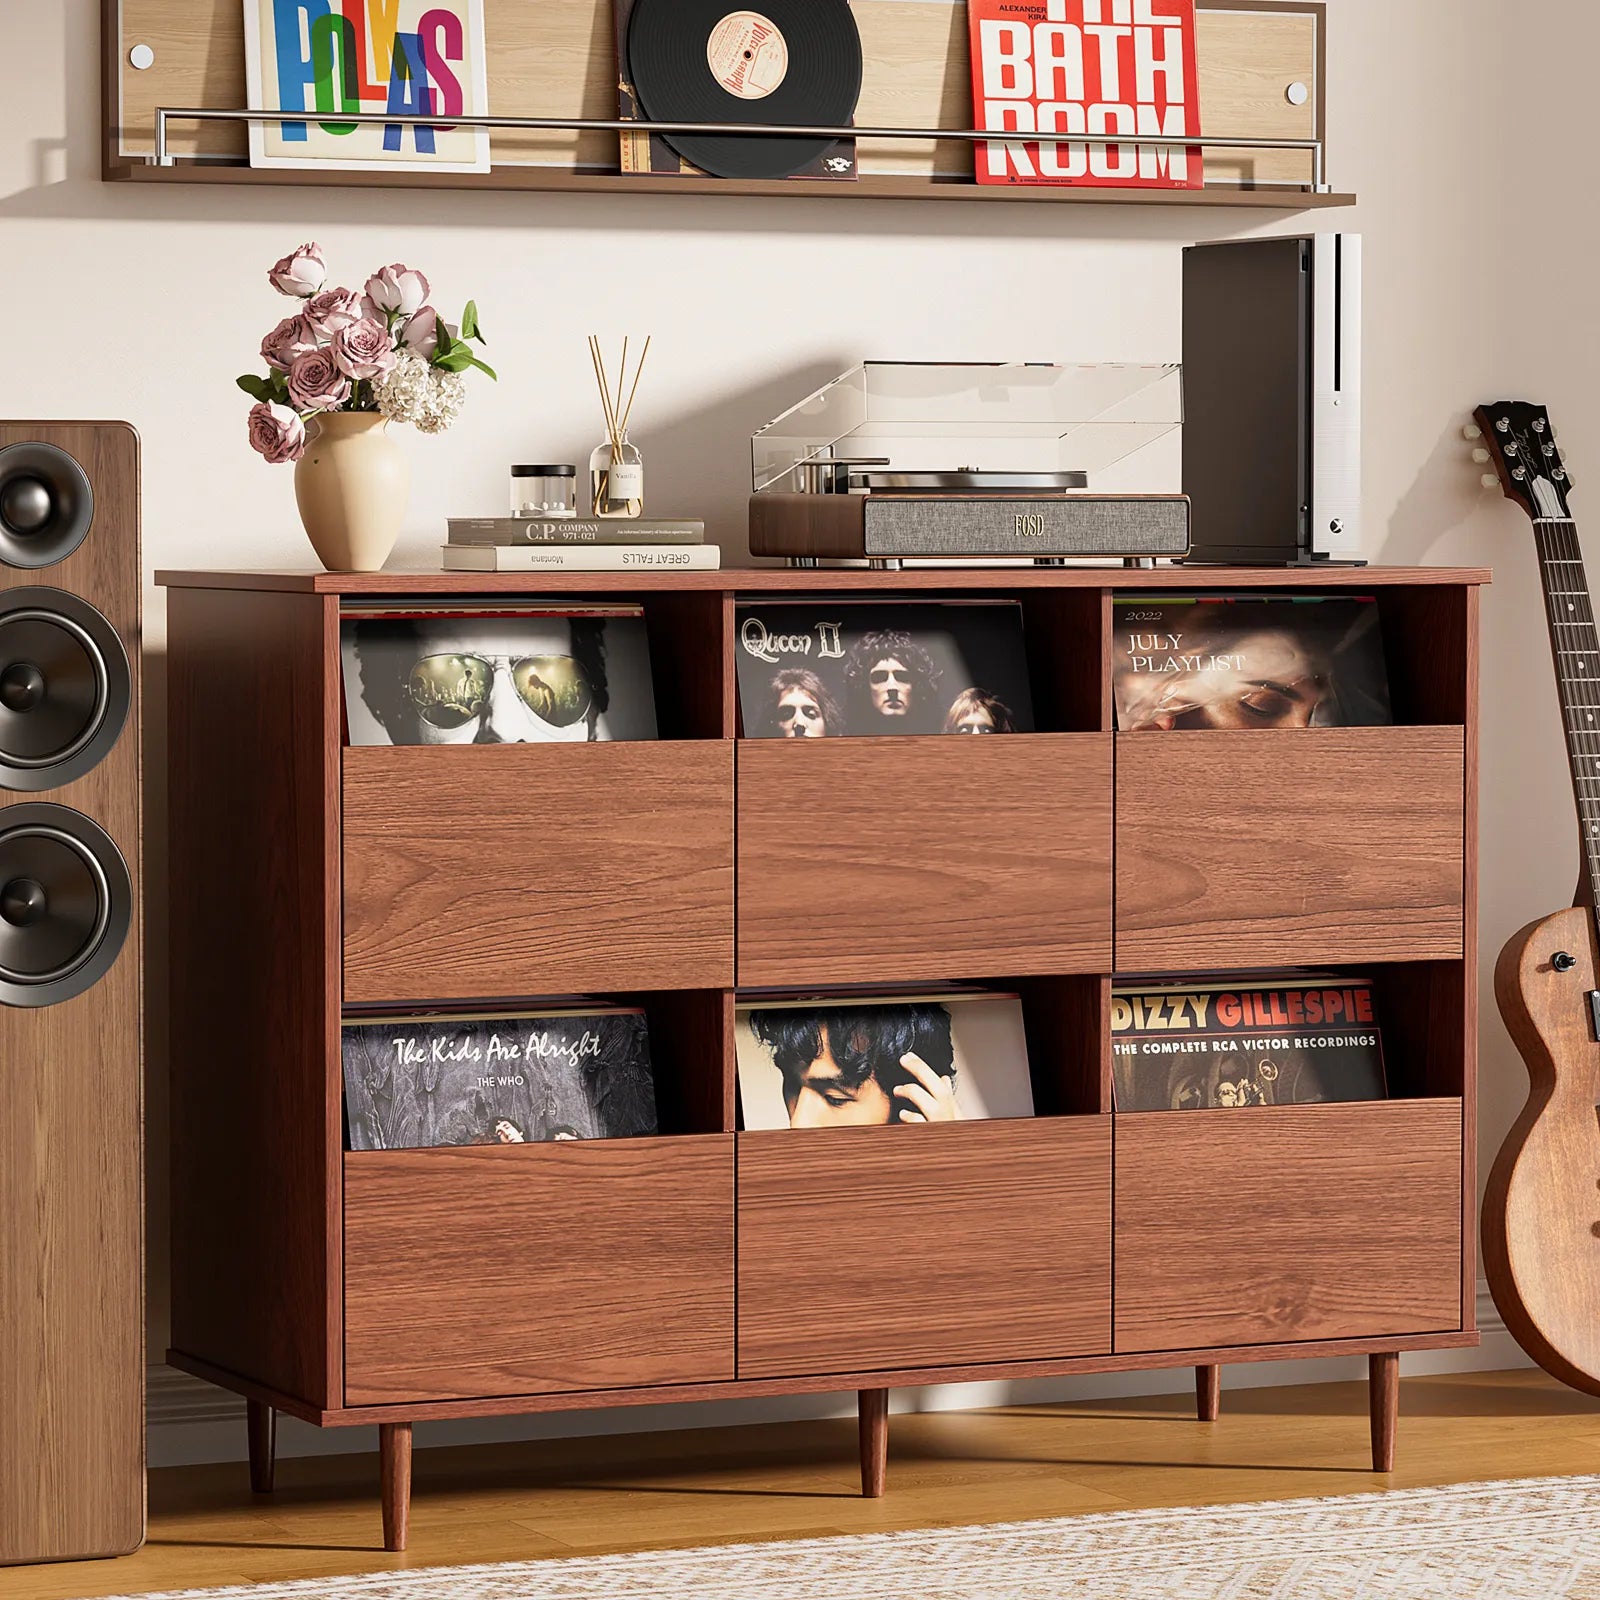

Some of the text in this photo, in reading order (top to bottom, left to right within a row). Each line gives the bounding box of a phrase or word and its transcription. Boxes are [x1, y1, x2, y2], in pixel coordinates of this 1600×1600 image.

[999, 5, 1047, 13] ALEXANDER
[979, 19, 1184, 103] BATH
[984, 100, 1187, 180] ROOM
[525, 523, 599, 540] C.P. COMPANY
[1014, 514, 1044, 536] FOSD
[531, 555, 563, 564] Montana
[622, 553, 690, 564] GREAT FALLS
[1125, 611, 1162, 621] 2022
[741, 618, 811, 663] Queen
[1127, 634, 1182, 654] JULY
[1132, 655, 1246, 672] PLAYLIST
[1111, 990, 1374, 1031] DIZZY GILLESPIE
[393, 1031, 601, 1066] The Kids Are Alright
[1114, 1035, 1376, 1055] THE COMPLETE RCA VICTOR RECORDINGS
[477, 1076, 524, 1087] THE WHO
